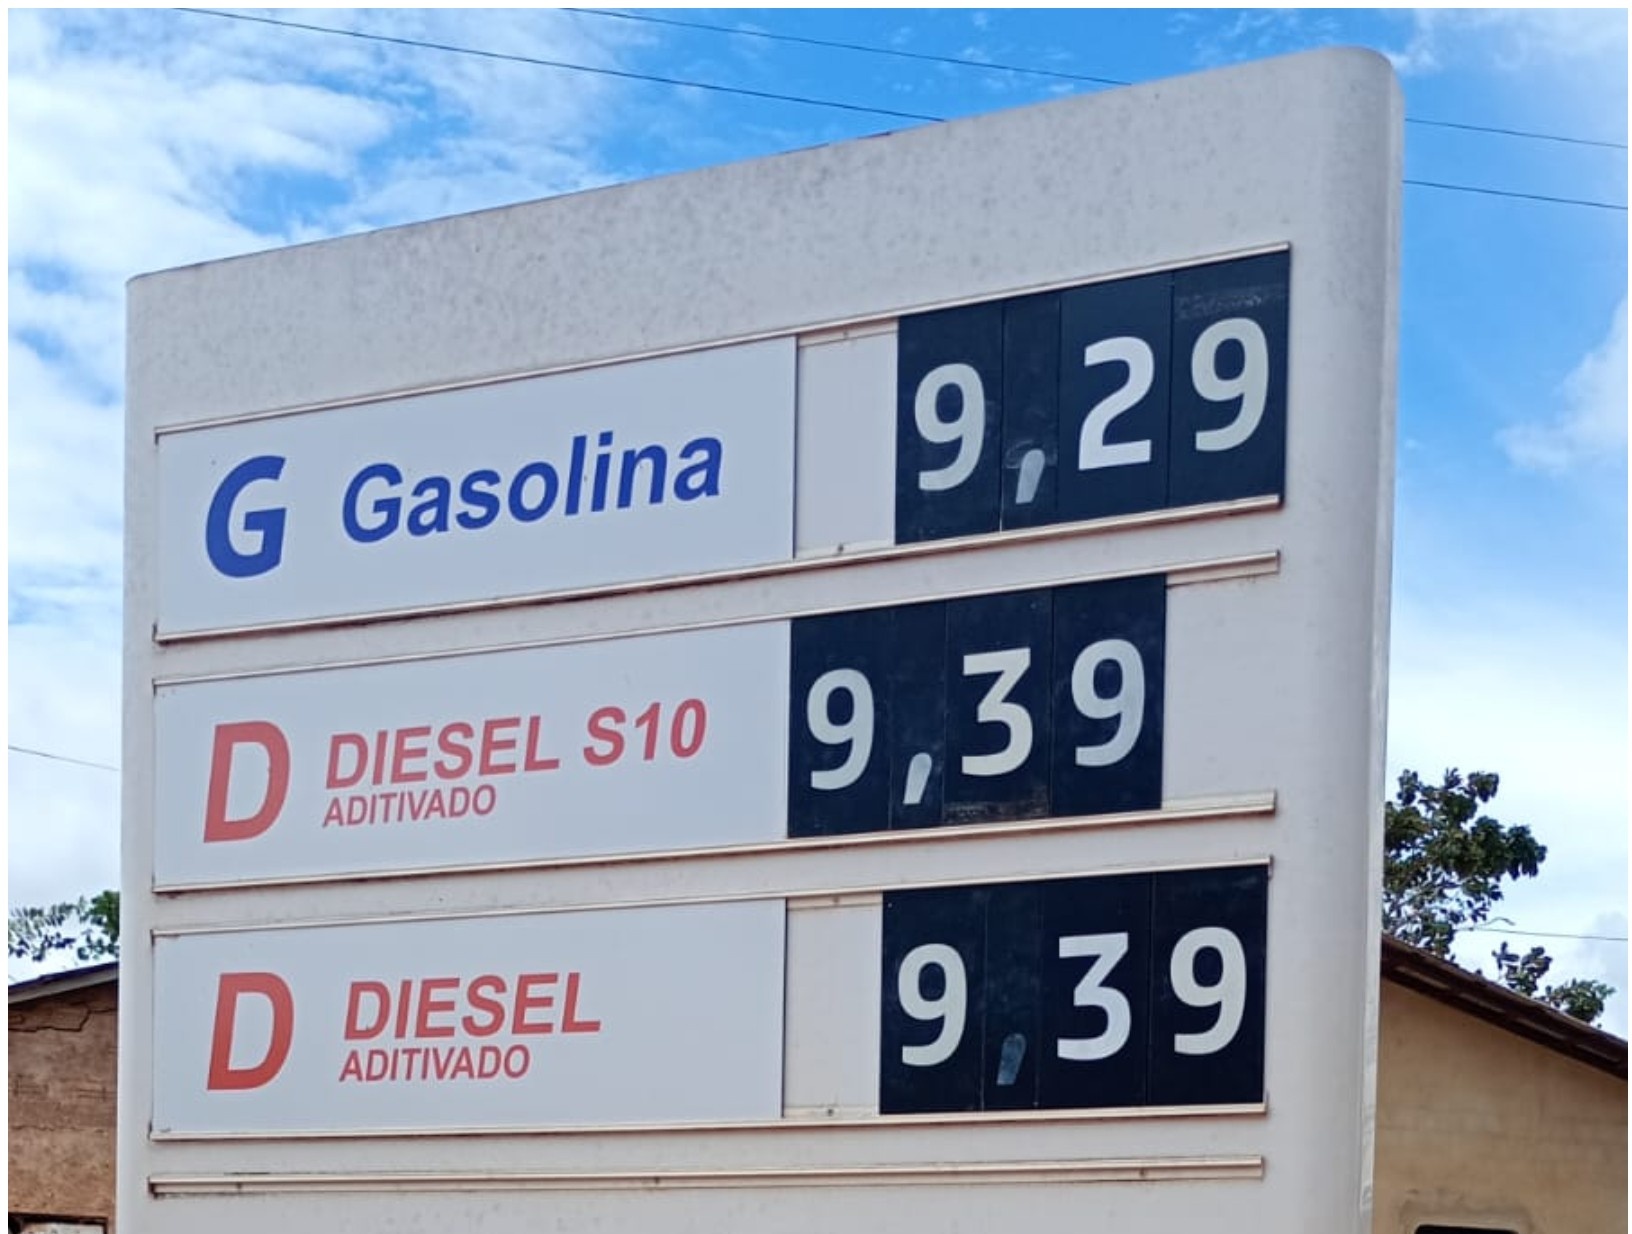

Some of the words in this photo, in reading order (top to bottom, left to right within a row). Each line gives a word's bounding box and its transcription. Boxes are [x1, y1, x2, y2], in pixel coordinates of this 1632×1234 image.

[914, 316, 1269, 505] 9,29
[204, 453, 288, 579] G
[341, 430, 724, 544] Gasolina
[204, 721, 290, 842] D
[326, 715, 560, 789] DIESEL
[583, 698, 707, 766] S10
[806, 637, 1146, 805] 9,39
[322, 784, 497, 828] ADITIVADO
[207, 972, 293, 1090] D
[344, 972, 601, 1040] DIESEL
[338, 1044, 530, 1082] ADITIVADO
